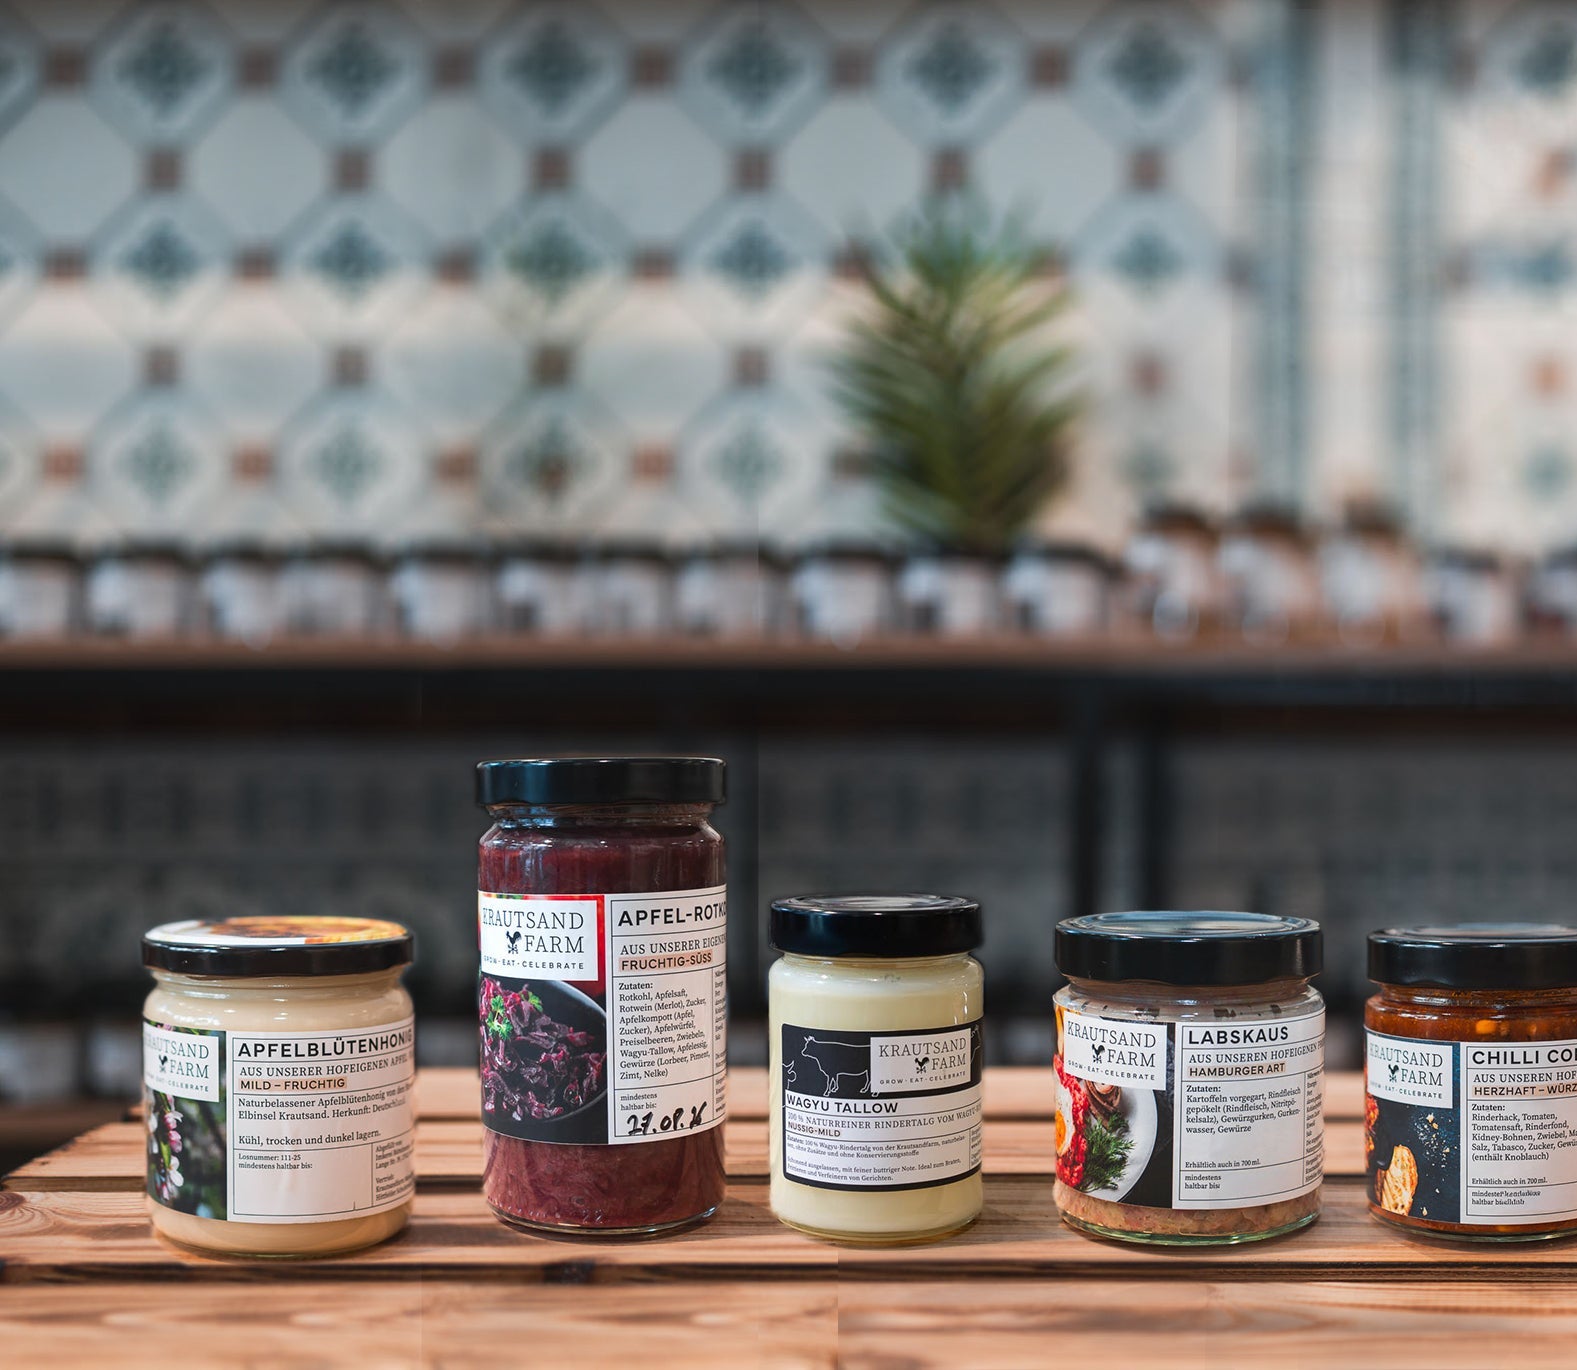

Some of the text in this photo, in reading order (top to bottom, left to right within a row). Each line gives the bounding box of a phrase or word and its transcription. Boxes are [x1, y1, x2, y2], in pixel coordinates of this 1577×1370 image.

[483, 907, 584, 929] KRAUTSAND
[525, 936, 584, 953] FARM
[621, 940, 700, 955] AUS UNSERER
[522, 961, 584, 970] CELEBRATE
[622, 952, 712, 970] FRUCHTIG-SÜSS
[619, 981, 653, 990] Zutaten:
[619, 989, 688, 1002] Rotkohl, Apfelsaft,
[619, 1000, 685, 1012] Rotwein (Merlot),
[619, 1010, 695, 1024] Apfelkompott (Apfel,
[620, 1035, 674, 1047] Preiselbeeren,
[1068, 1020, 1156, 1048] KRAUTSAND
[1189, 1026, 1288, 1045] LABSKAUS
[879, 1038, 967, 1057] KRAUTSAND
[1189, 1043, 1317, 1063] AUS UNSEREN HOFEIGENEN
[620, 1055, 688, 1069] Gewürze (Lorbeer,
[932, 1055, 966, 1070] FARM
[1107, 1050, 1156, 1068] FARM
[1472, 1050, 1539, 1064] CHILLI
[170, 1064, 209, 1079] FARM
[240, 1057, 388, 1076] AUS UNSERER HOFEIGENEN
[1190, 1063, 1285, 1076] HAMBURGER ART
[930, 1071, 966, 1081] CELEBRATE
[1104, 1069, 1155, 1080] CELEBRATE
[1401, 1069, 1443, 1086] FARM
[1473, 1073, 1495, 1082] AUS
[1500, 1072, 1552, 1082] UNSEREN
[168, 1080, 209, 1092] CELEBRATE
[241, 1079, 345, 1090] MILD FRUCHTIG
[1186, 1085, 1221, 1093] Zutaten:
[1475, 1086, 1536, 1096] HERZHAFT
[238, 1091, 385, 1108] Naturbelassener Apfelblütenhonig
[1186, 1087, 1301, 1103] Kartoffeln vorgegart, Rindfleisch
[1399, 1088, 1442, 1099] CELEBRATE
[787, 1094, 898, 1113] WAGYU TALLOW
[1186, 1101, 1269, 1115] gepökelt (Rindfleisch,
[238, 1105, 371, 1120] Elbinsel Krautsand. Herkunft:
[1220, 1111, 1276, 1124] Gewürzgurken,
[806, 1114, 954, 1129] NATURREINER RINDERTALG VOM
[1472, 1121, 1569, 1132] Tomatensaft, Rinderfond,
[788, 1122, 841, 1137] NUSSIG-MILD
[1186, 1124, 1251, 1135] wasser, Gewürze
[238, 1129, 381, 1146] Kühl, trocken und dunkel lagern.
[1472, 1131, 1566, 1143] Kidney-Bohnen, Zwiebel,
[819, 1140, 940, 1152] Wagyu-Rindertalg Krautsandfarm,
[856, 1150, 919, 1158] Konservierungsstoffe
[1472, 1152, 1549, 1162] (enthält Knoblauch)
